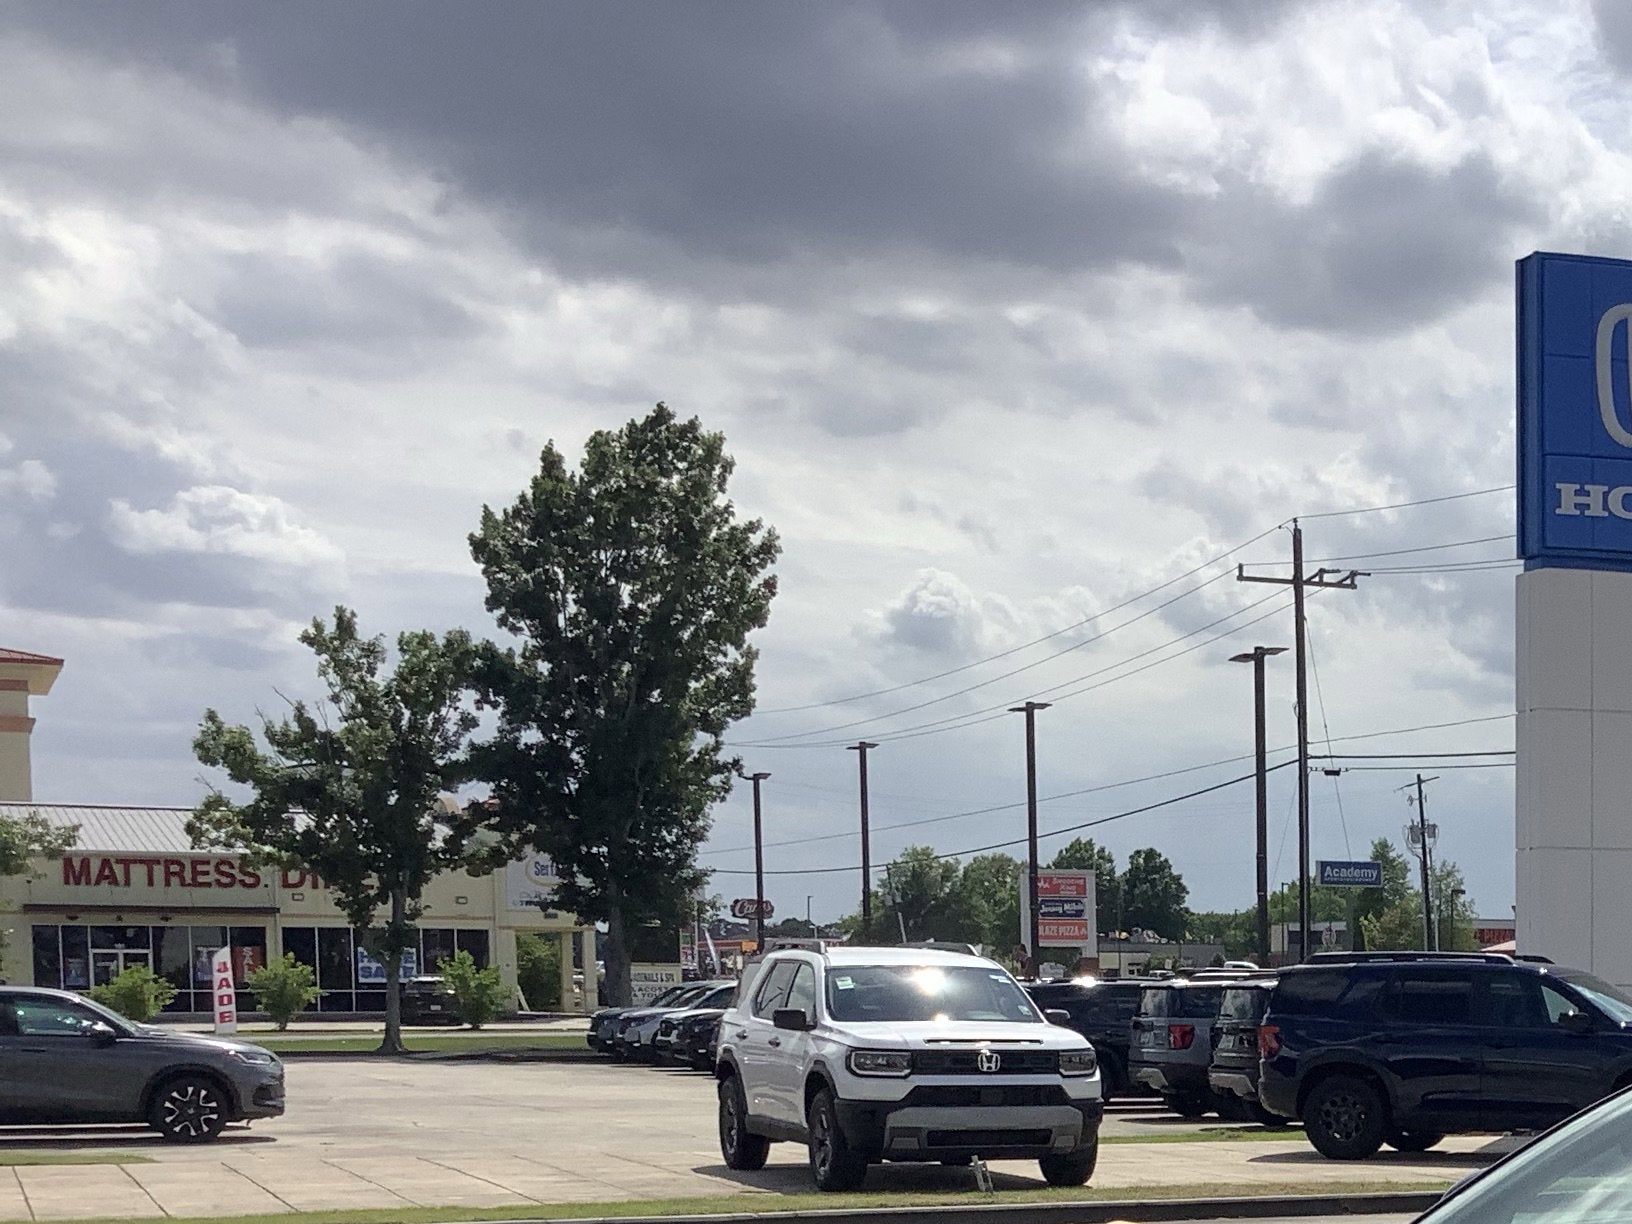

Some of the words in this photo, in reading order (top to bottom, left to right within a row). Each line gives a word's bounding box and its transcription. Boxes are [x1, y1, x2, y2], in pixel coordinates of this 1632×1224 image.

[62, 856, 261, 889] MATTRESS
[1324, 865, 1378, 881] Academy
[1059, 925, 1080, 936] PIZZA
